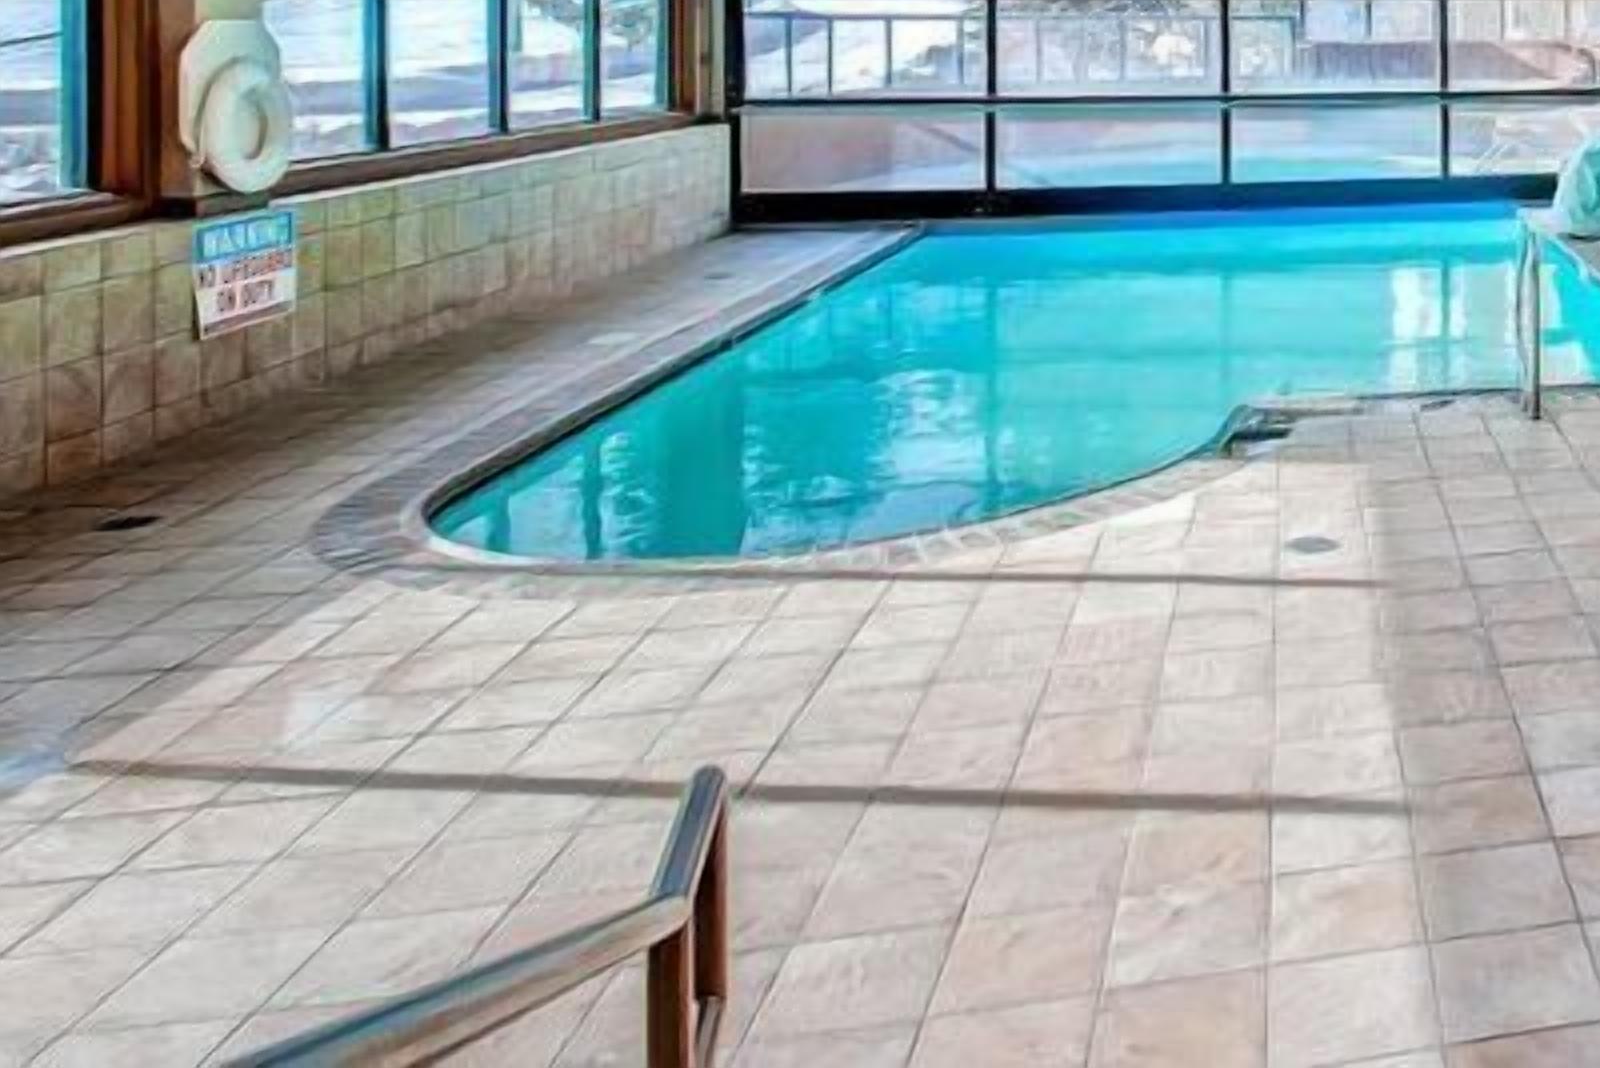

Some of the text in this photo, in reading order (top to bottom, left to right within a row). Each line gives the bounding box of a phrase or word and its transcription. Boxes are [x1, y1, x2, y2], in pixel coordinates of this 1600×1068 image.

[198, 264, 215, 288] NO
[217, 280, 273, 312] ON DUTY
